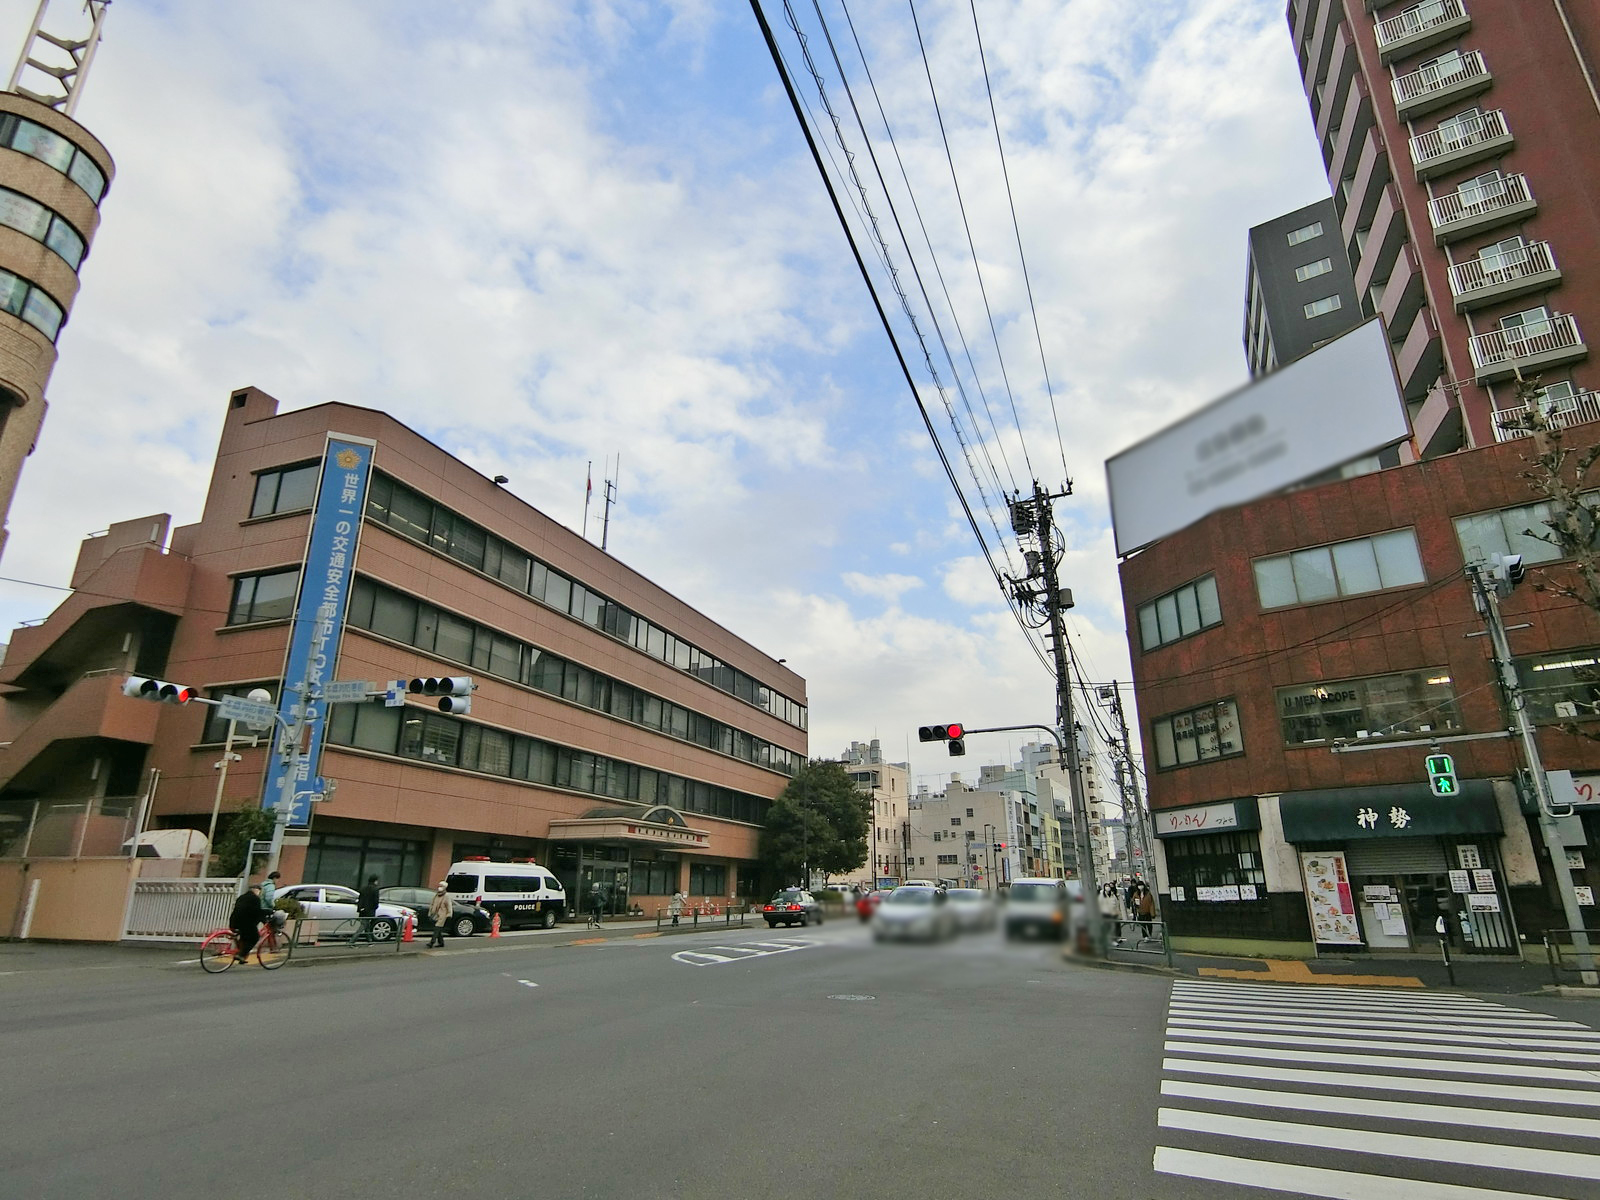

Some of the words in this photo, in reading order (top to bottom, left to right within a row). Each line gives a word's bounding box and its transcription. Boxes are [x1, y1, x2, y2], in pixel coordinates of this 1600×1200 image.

[1320, 690, 1357, 704] SCOPE
[1573, 779, 1600, 801] ら
[1356, 806, 1411, 830] 神勢
